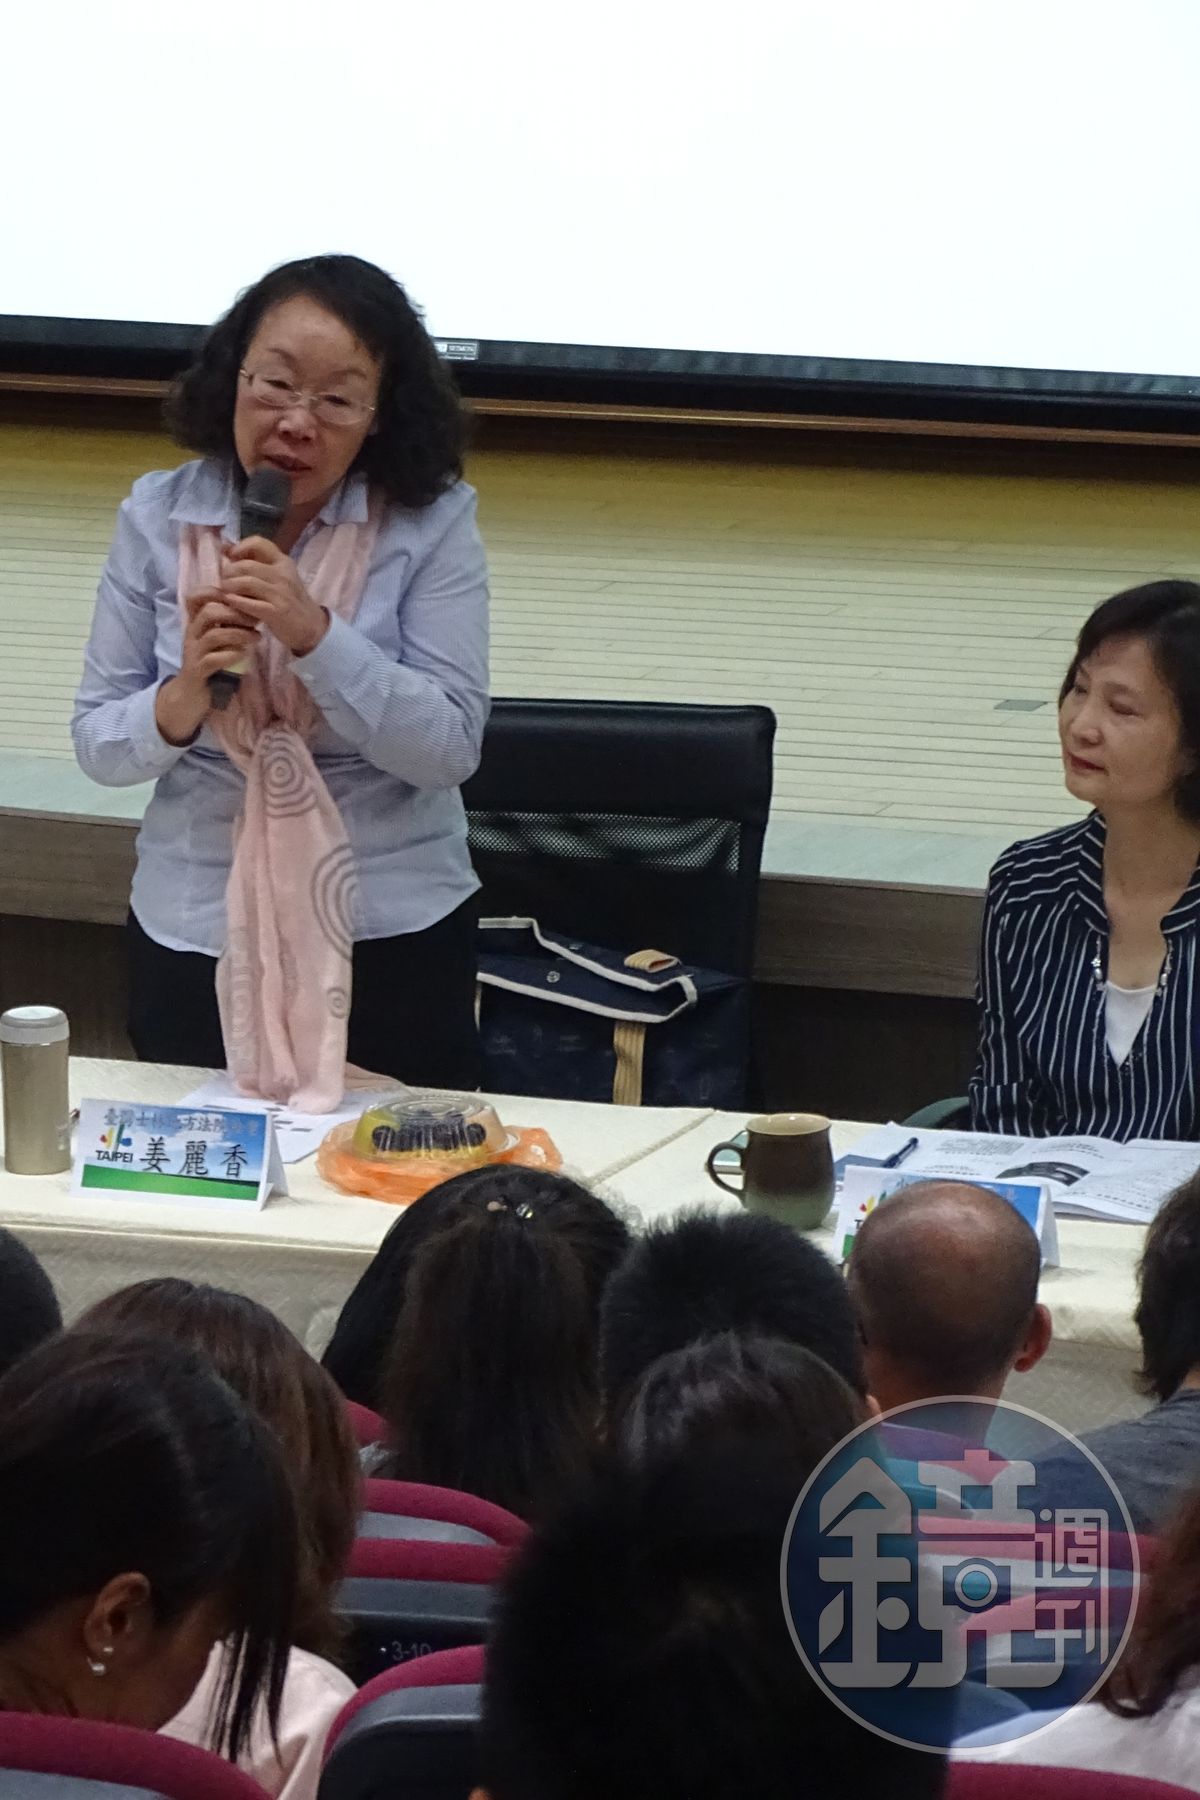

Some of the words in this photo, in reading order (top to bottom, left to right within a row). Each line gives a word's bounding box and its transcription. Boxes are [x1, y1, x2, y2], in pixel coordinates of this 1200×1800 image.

[95, 1150, 133, 1163] TAIPEI
[139, 1136, 248, 1178] 姜麗香
